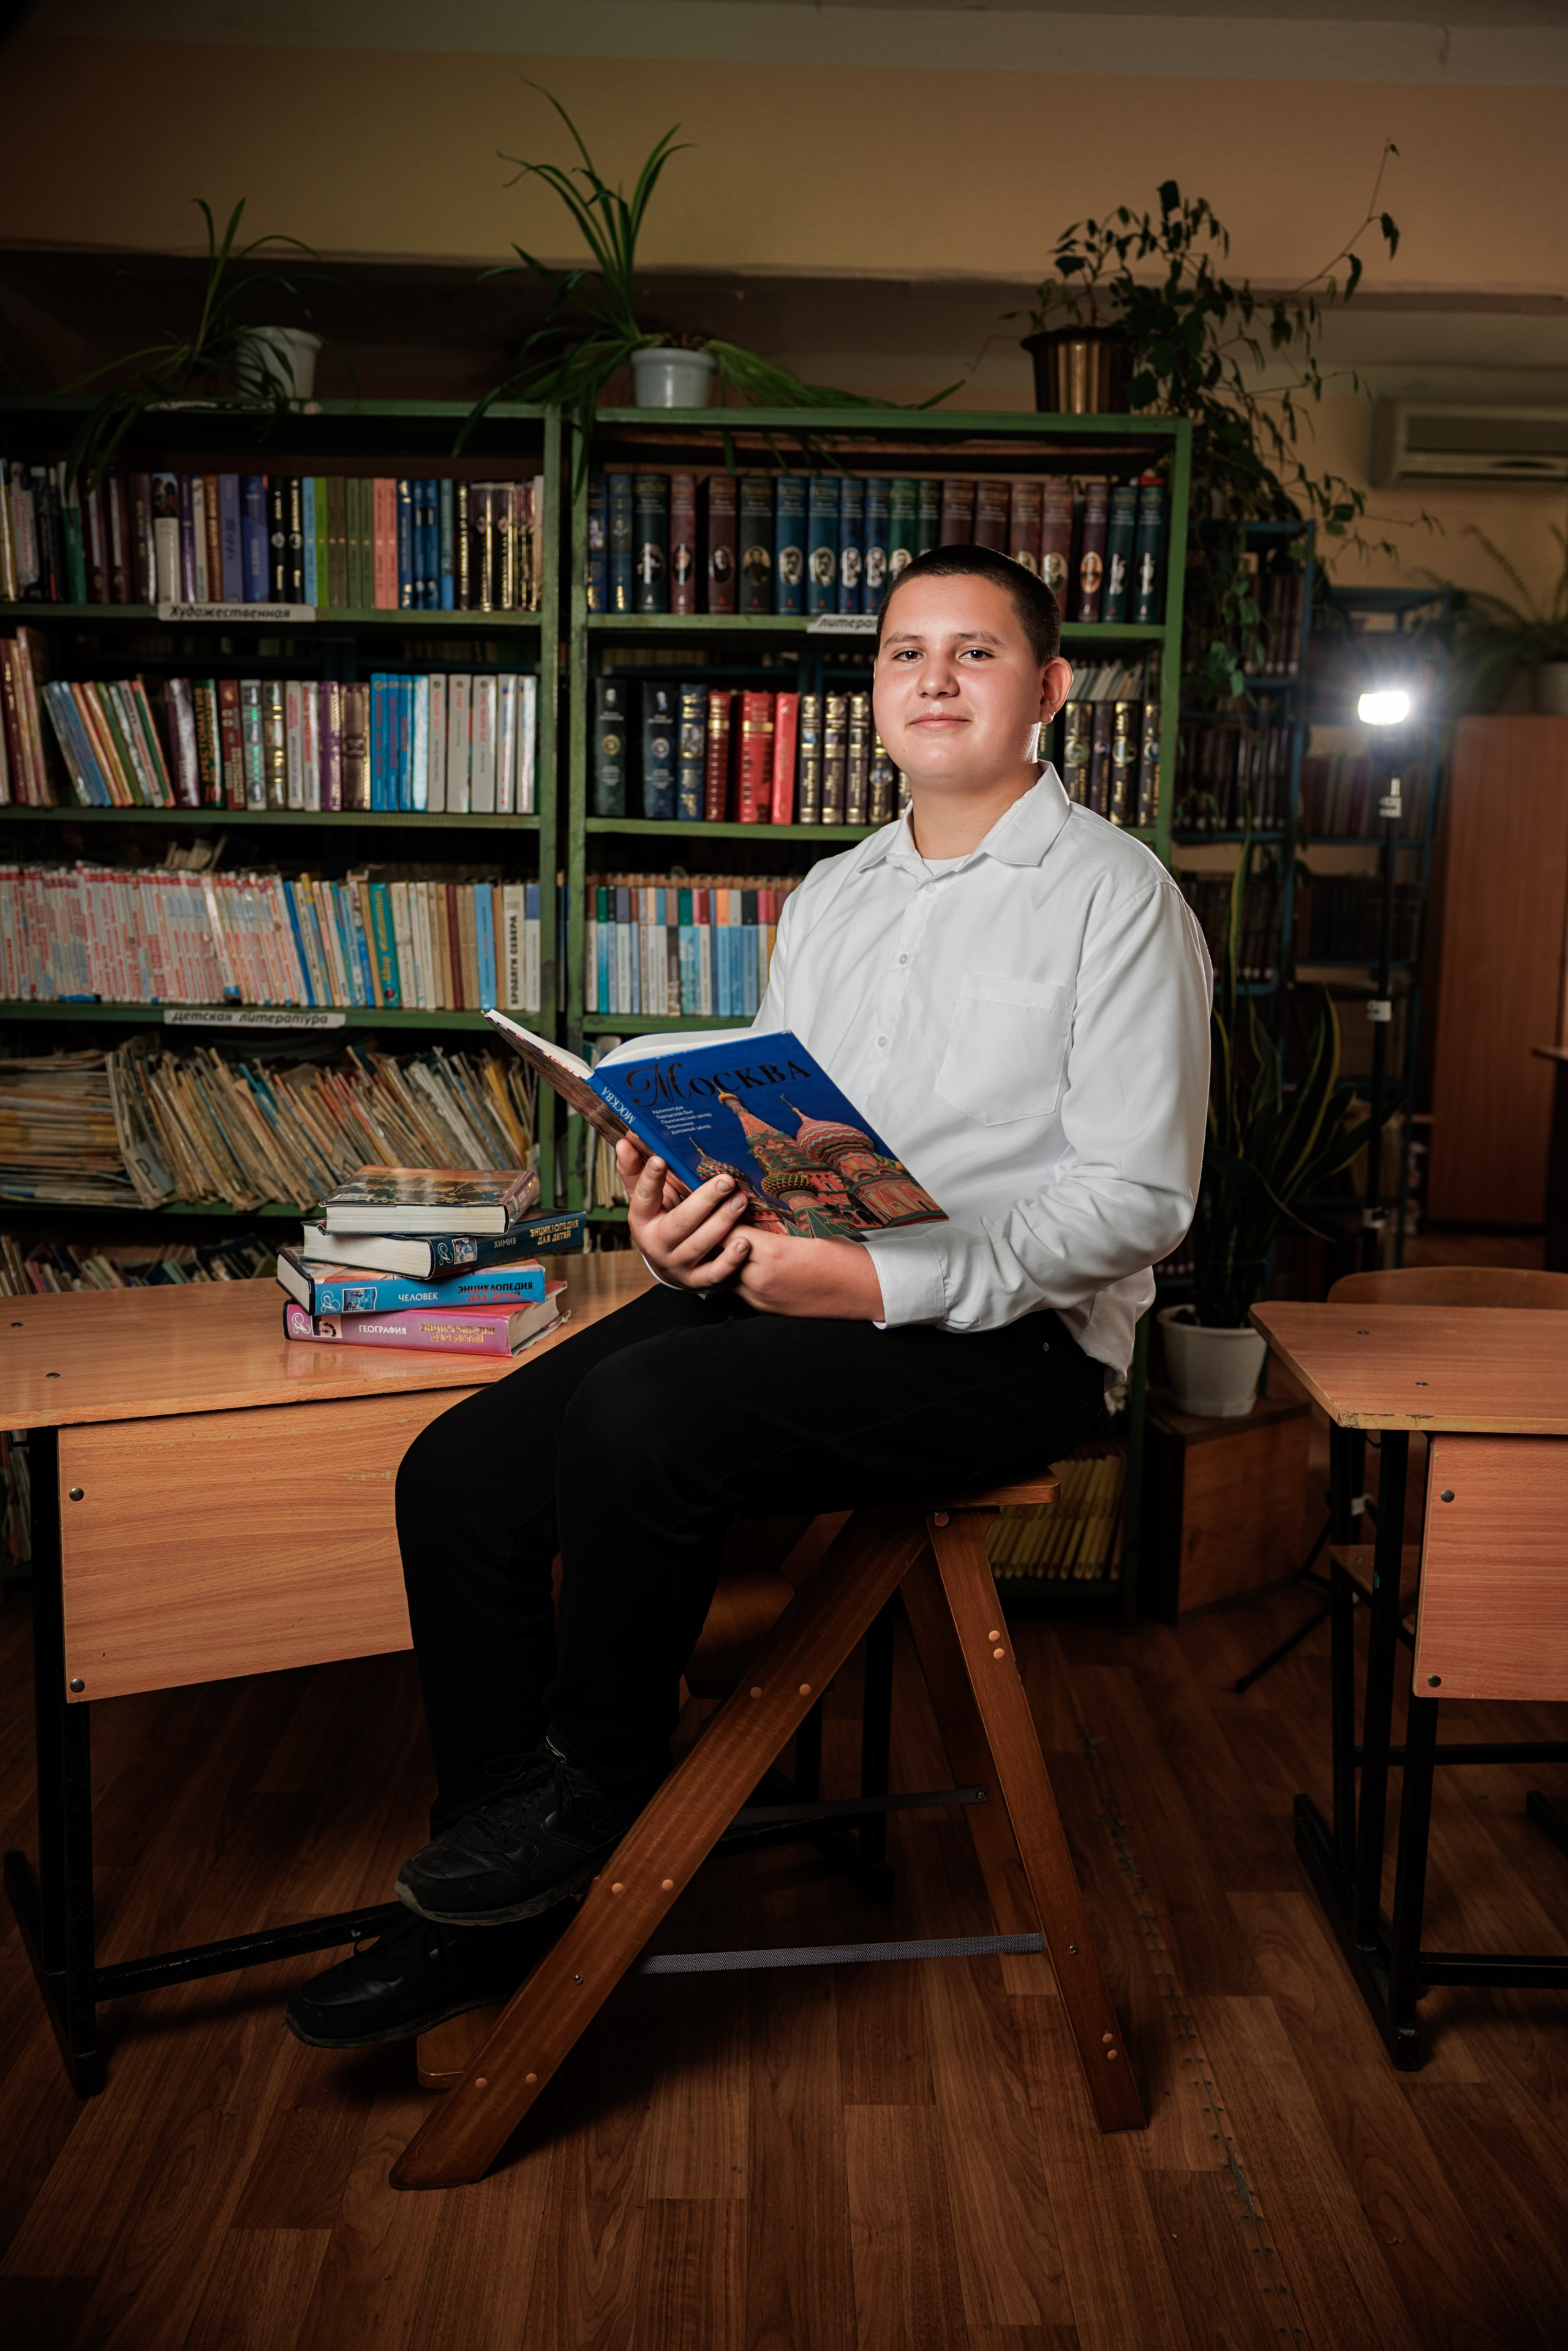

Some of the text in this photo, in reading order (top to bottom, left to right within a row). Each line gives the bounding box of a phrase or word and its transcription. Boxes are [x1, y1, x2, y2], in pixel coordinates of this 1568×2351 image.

[170, 605, 290, 618] Художественная
[819, 618, 878, 630] литера
[510, 914, 518, 955] СЕВЕРА
[172, 1011, 328, 1025] Детская литература
[601, 1086, 636, 1125] МОСКВА
[652, 1106, 684, 1114] Архитектура
[660, 1115, 697, 1124] Политический
[529, 1220, 579, 1237] ЭНЦИКЛОПЕДИЯ
[494, 1237, 516, 1248] ХИМИЯ
[537, 1229, 571, 1246] ДЛЯ ДЕТЕЙ
[458, 1281, 533, 1294] ЭНЦИКЛОПЕДИЯ
[398, 1292, 439, 1302] ЧЕЛОВЕК
[468, 1291, 521, 1303] ДЛЯ ДЕТЕЙ
[359, 1324, 407, 1335] ГЕОГРАФИЯ
[420, 1323, 496, 1335] ЭНЦИКЛОПЕДИЯ
[431, 1333, 484, 1343] ДЛЯ ДЕТЕЙ
